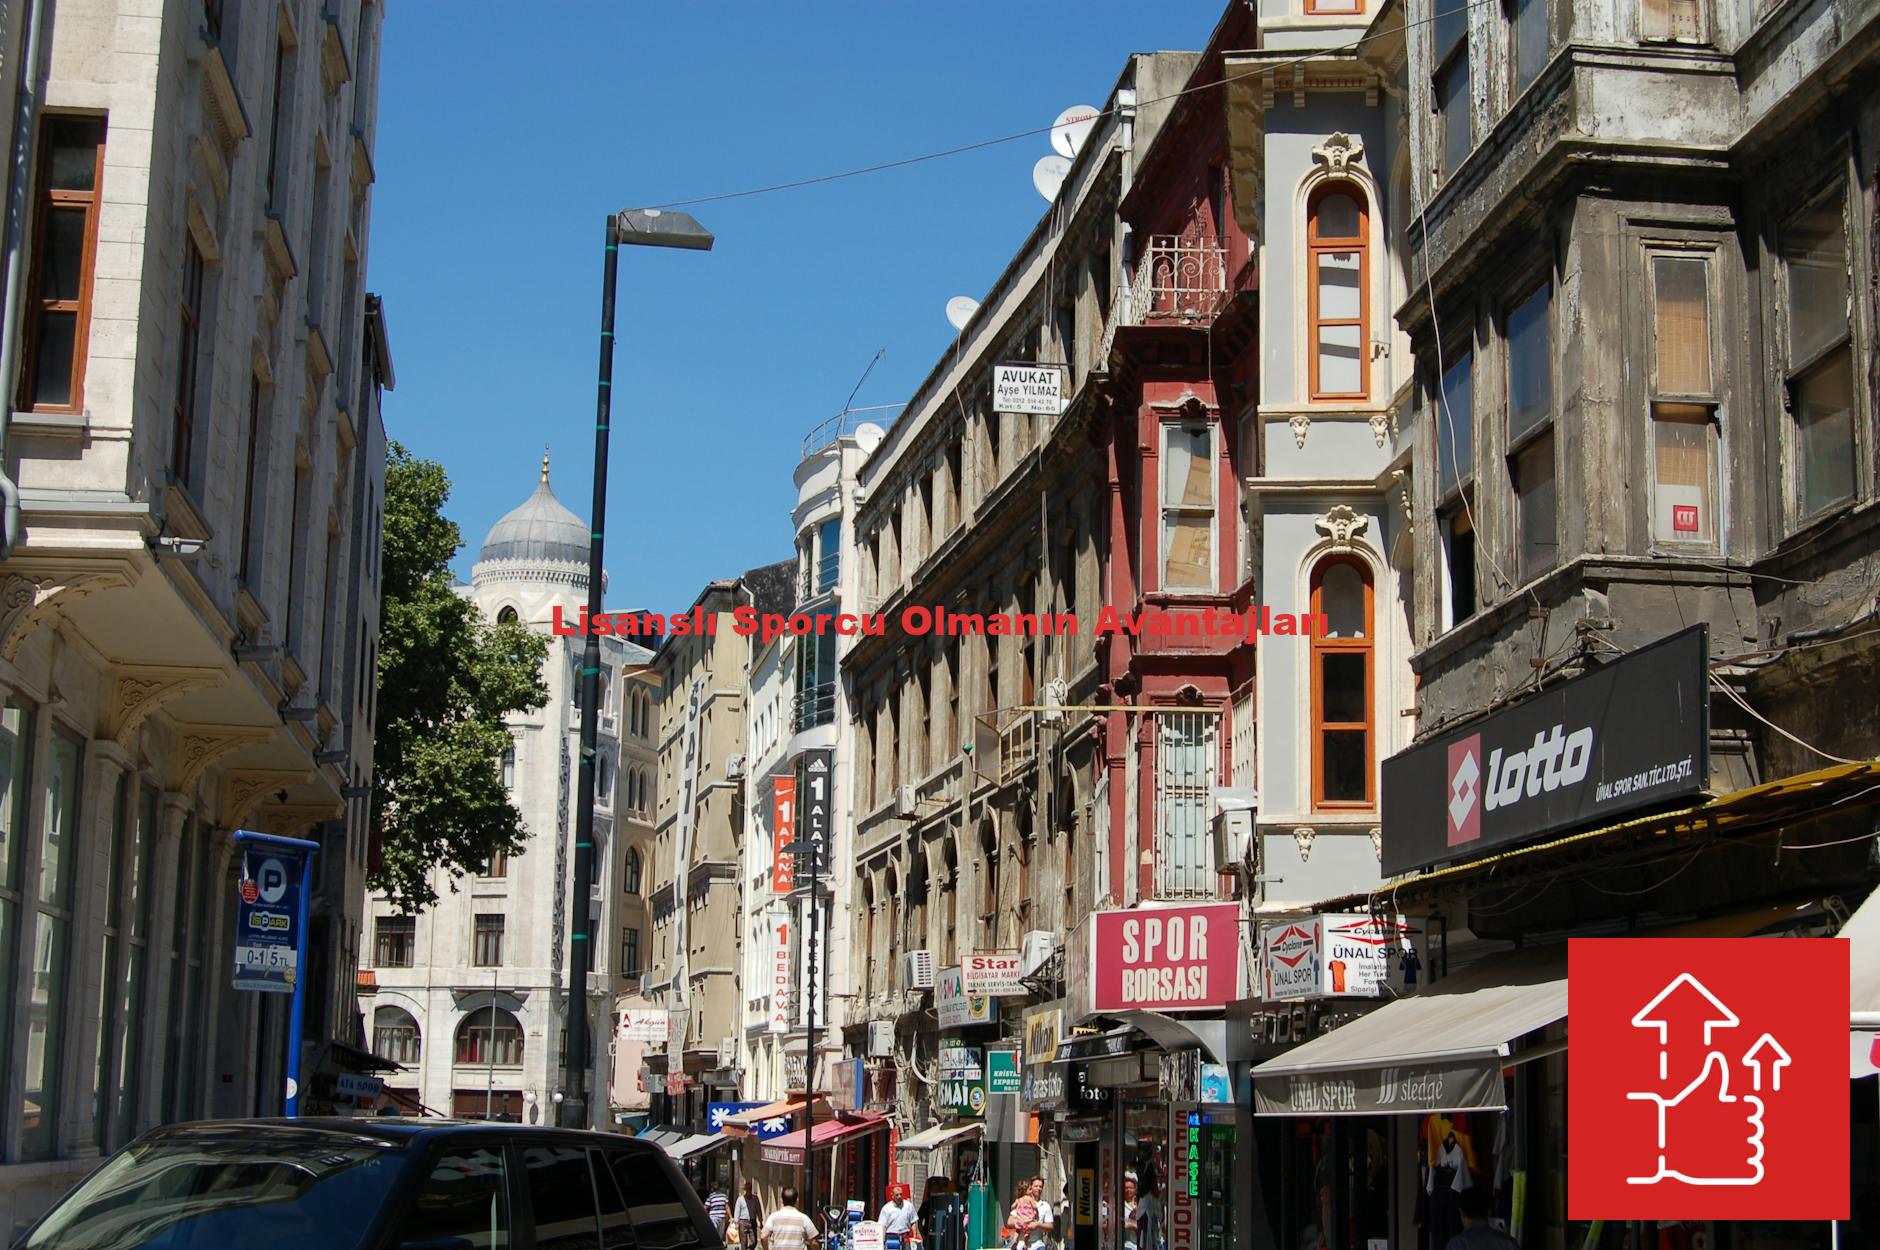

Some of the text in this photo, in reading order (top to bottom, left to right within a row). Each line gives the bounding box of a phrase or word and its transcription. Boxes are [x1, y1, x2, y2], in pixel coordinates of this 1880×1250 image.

[1002, 370, 1054, 384] AVUKAT
[998, 384, 1058, 396] Ayşe YILMAZ
[1485, 724, 1593, 811] lotto
[811, 777, 823, 800] 1
[1596, 782, 1613, 802] ÜNAL
[1613, 777, 1633, 797] SPOR
[778, 801, 790, 823] 1
[264, 869, 282, 892] P
[1122, 915, 1208, 964] SPOR
[1333, 944, 1373, 959] ÜNAL
[270, 952, 278, 965] 5
[972, 958, 1018, 970] Star
[775, 924, 787, 1021] 1 BEDAVA
[1122, 965, 1208, 1003] BORSASI
[1274, 967, 1312, 986] ÜNAL SPOR
[1030, 1020, 1055, 1056] Nikon
[1290, 1076, 1357, 1112] ÜNAL SPOR
[1188, 1127, 1200, 1196] KAŞE
[1080, 1177, 1091, 1217] Nikon
